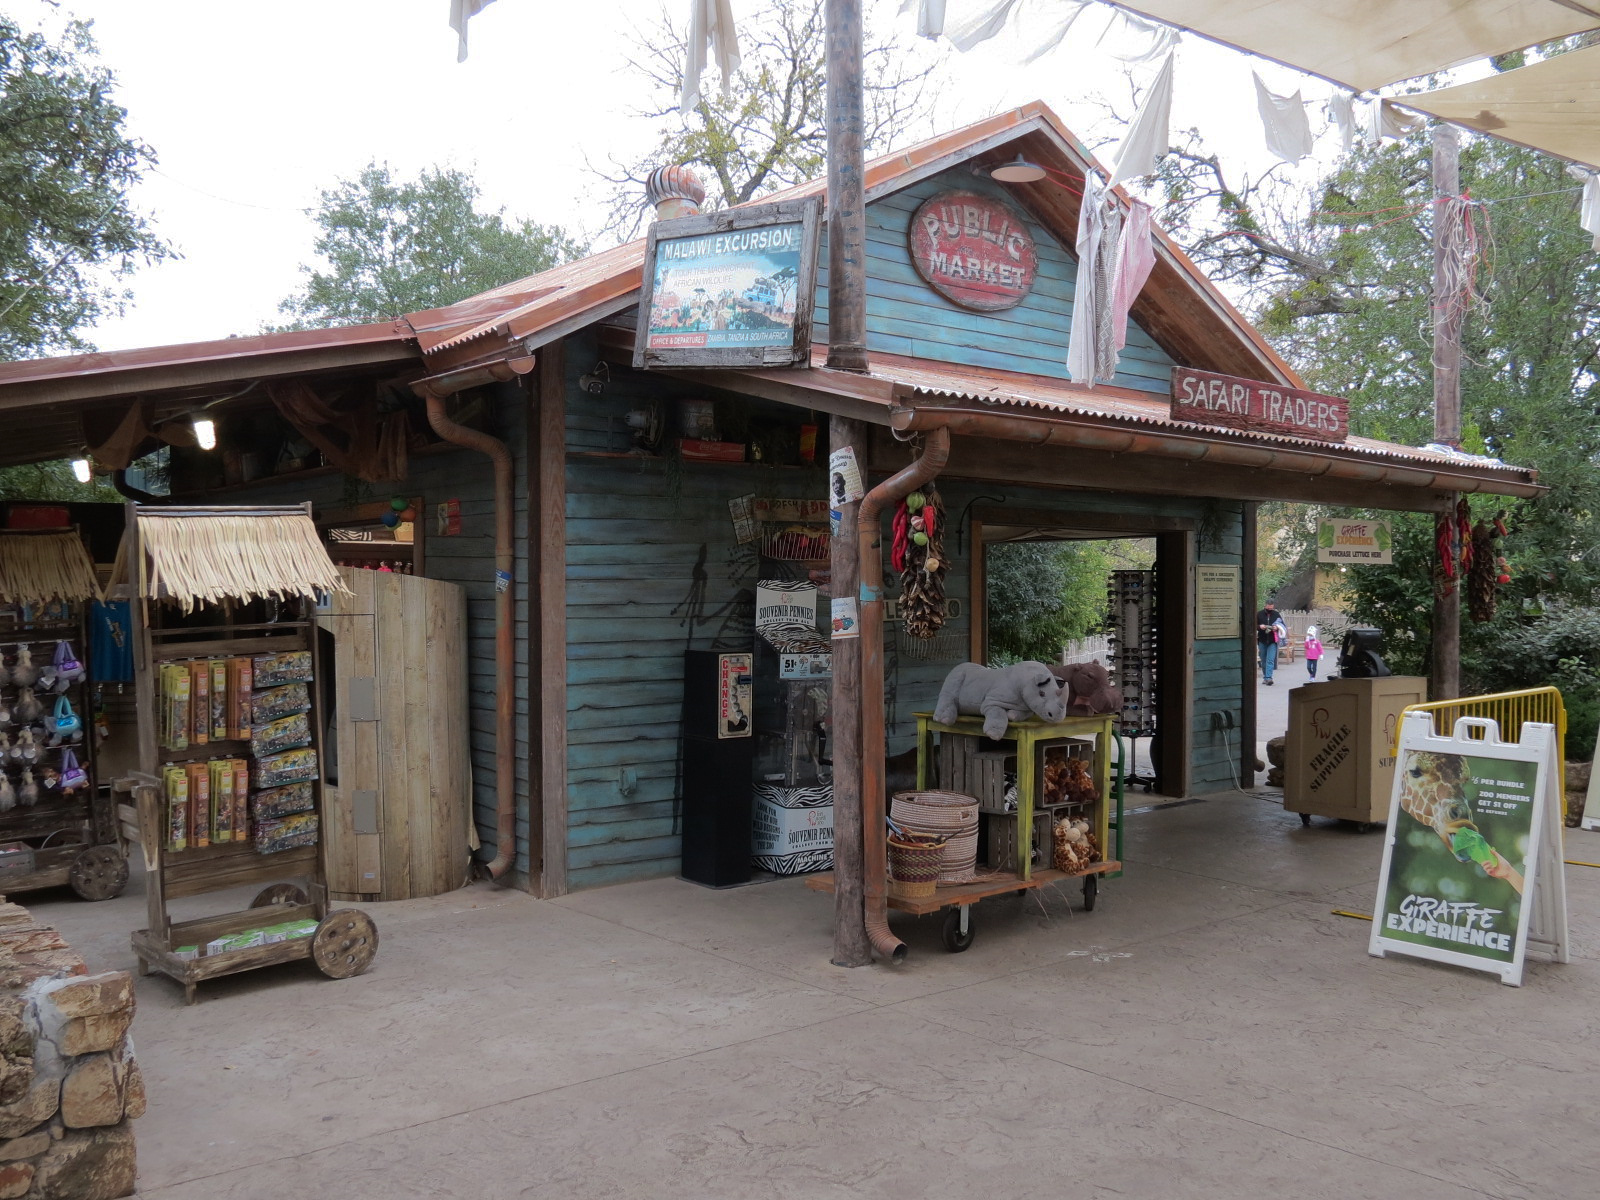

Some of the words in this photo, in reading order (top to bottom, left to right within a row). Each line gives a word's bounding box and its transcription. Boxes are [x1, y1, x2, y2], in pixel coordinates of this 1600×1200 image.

[922, 205, 1026, 262] PUBLIC
[664, 239, 711, 260] MALAWI
[716, 228, 793, 254] EXCURSION
[929, 250, 1025, 289] MARKET
[674, 335, 705, 345] DEPARTURES
[1180, 377, 1250, 415] SAFARI
[1259, 390, 1340, 432] TRADERS
[1341, 524, 1368, 537] GIRAFFE
[1336, 535, 1374, 546] EXPERIENCE
[1329, 550, 1351, 558] PURCHASE
[1371, 551, 1382, 559] HERE
[759, 604, 789, 620] SOUVENIR
[789, 605, 814, 621] PENNIES
[1310, 724, 1351, 771] FRAGILE
[1310, 745, 1350, 793] SUPPLIES
[1480, 778, 1495, 786] PER
[1496, 780, 1525, 789] BUNDLE
[1478, 799, 1491, 807] GET
[1503, 802, 1518, 810] OFF
[1479, 790, 1495, 798] ZOO
[1496, 792, 1530, 802] MEMBERS
[788, 828, 818, 845] SOUVENIR
[797, 854, 828, 864] MACHINE
[1399, 894, 1503, 931] GIRAFFE
[1387, 913, 1511, 952] EXPERIENCE
